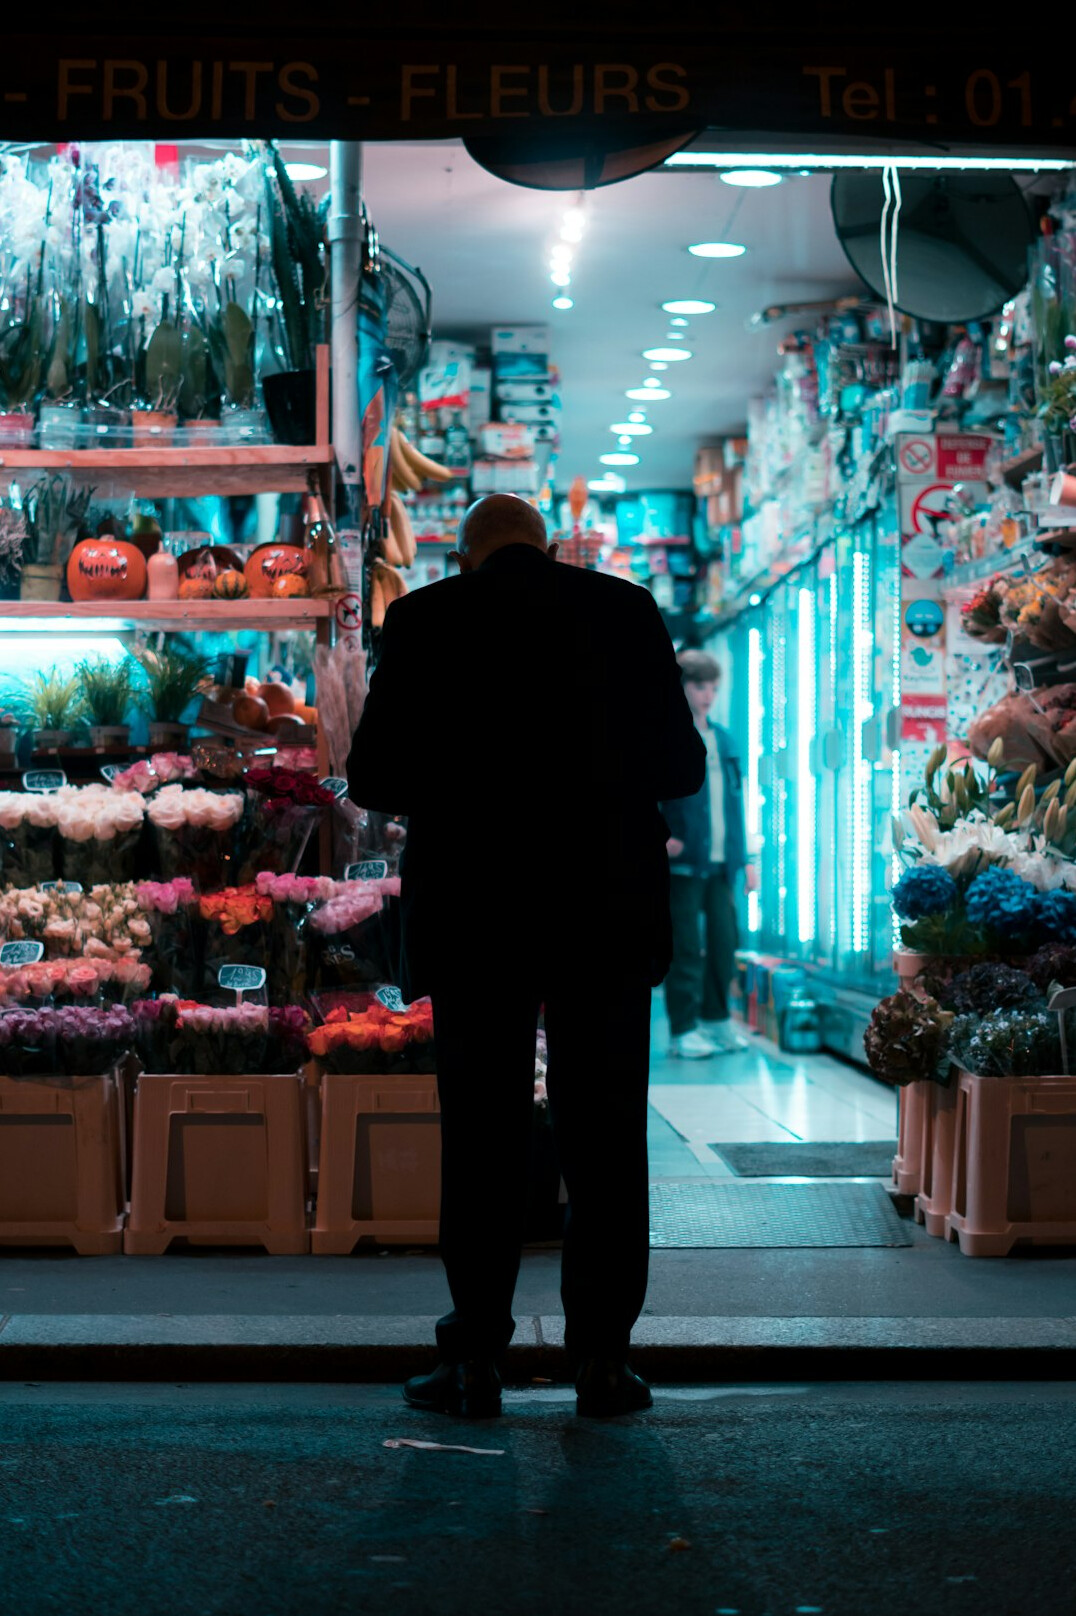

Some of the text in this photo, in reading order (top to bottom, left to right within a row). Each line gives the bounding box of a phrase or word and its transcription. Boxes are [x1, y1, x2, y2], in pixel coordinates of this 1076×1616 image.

[55, 58, 322, 123] FRUITS
[399, 62, 692, 122] FLEURS
[802, 65, 897, 122] Tel
